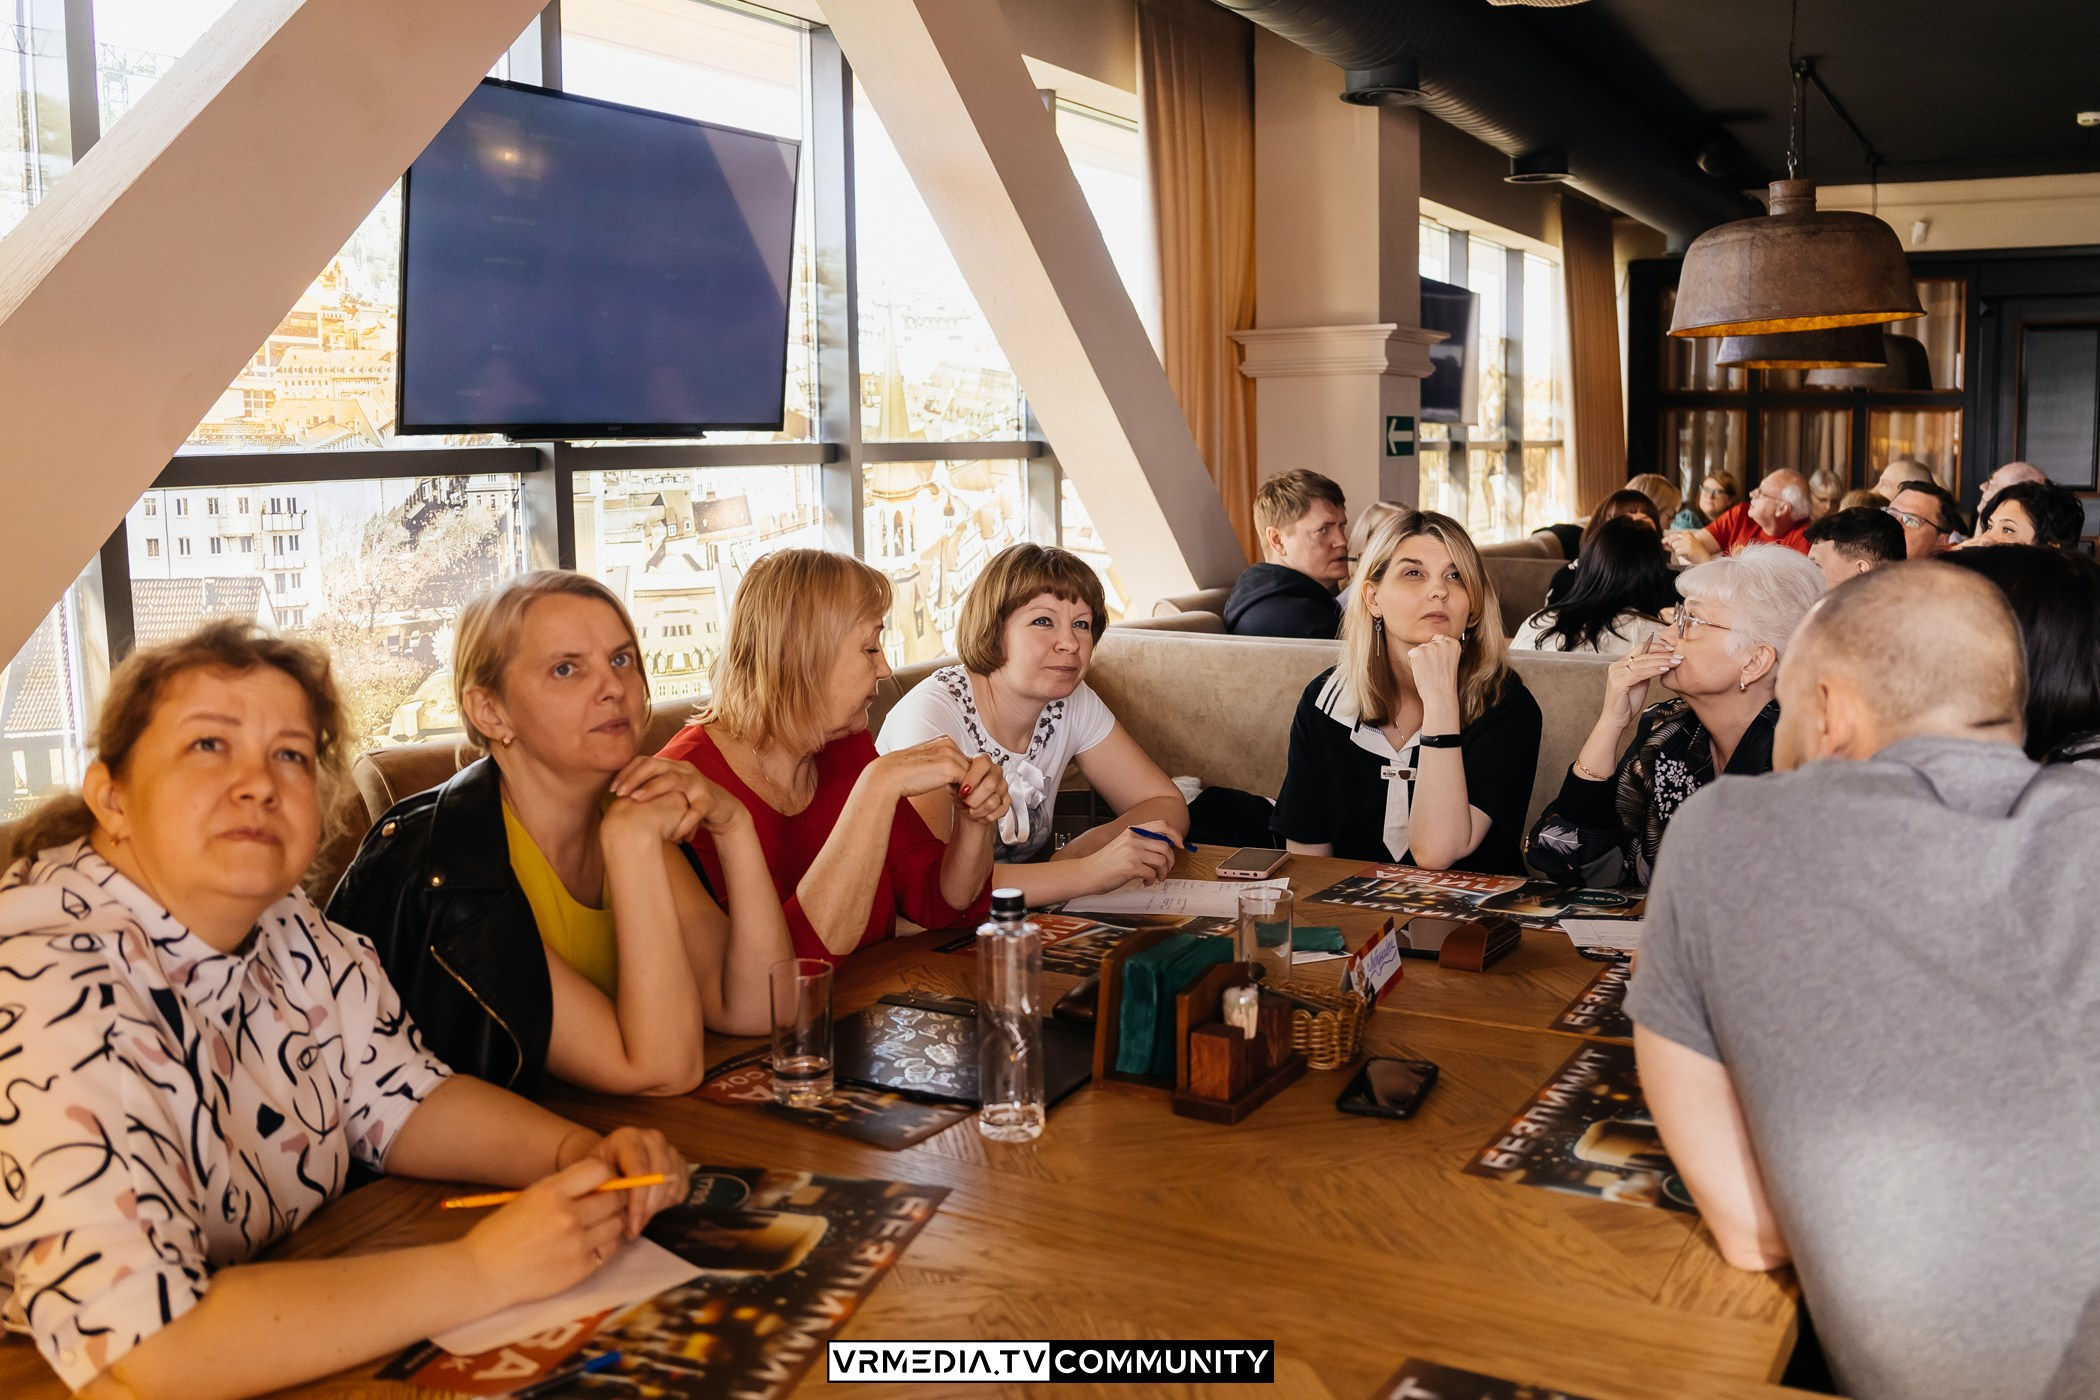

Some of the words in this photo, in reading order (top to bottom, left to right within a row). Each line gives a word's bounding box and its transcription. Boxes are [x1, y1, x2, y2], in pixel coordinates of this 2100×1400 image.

[1375, 869, 1507, 892] ПИВА
[1562, 961, 1631, 1027] БЕЗЛИМ
[1479, 1048, 1613, 1170] БЕЗЛИМИТ
